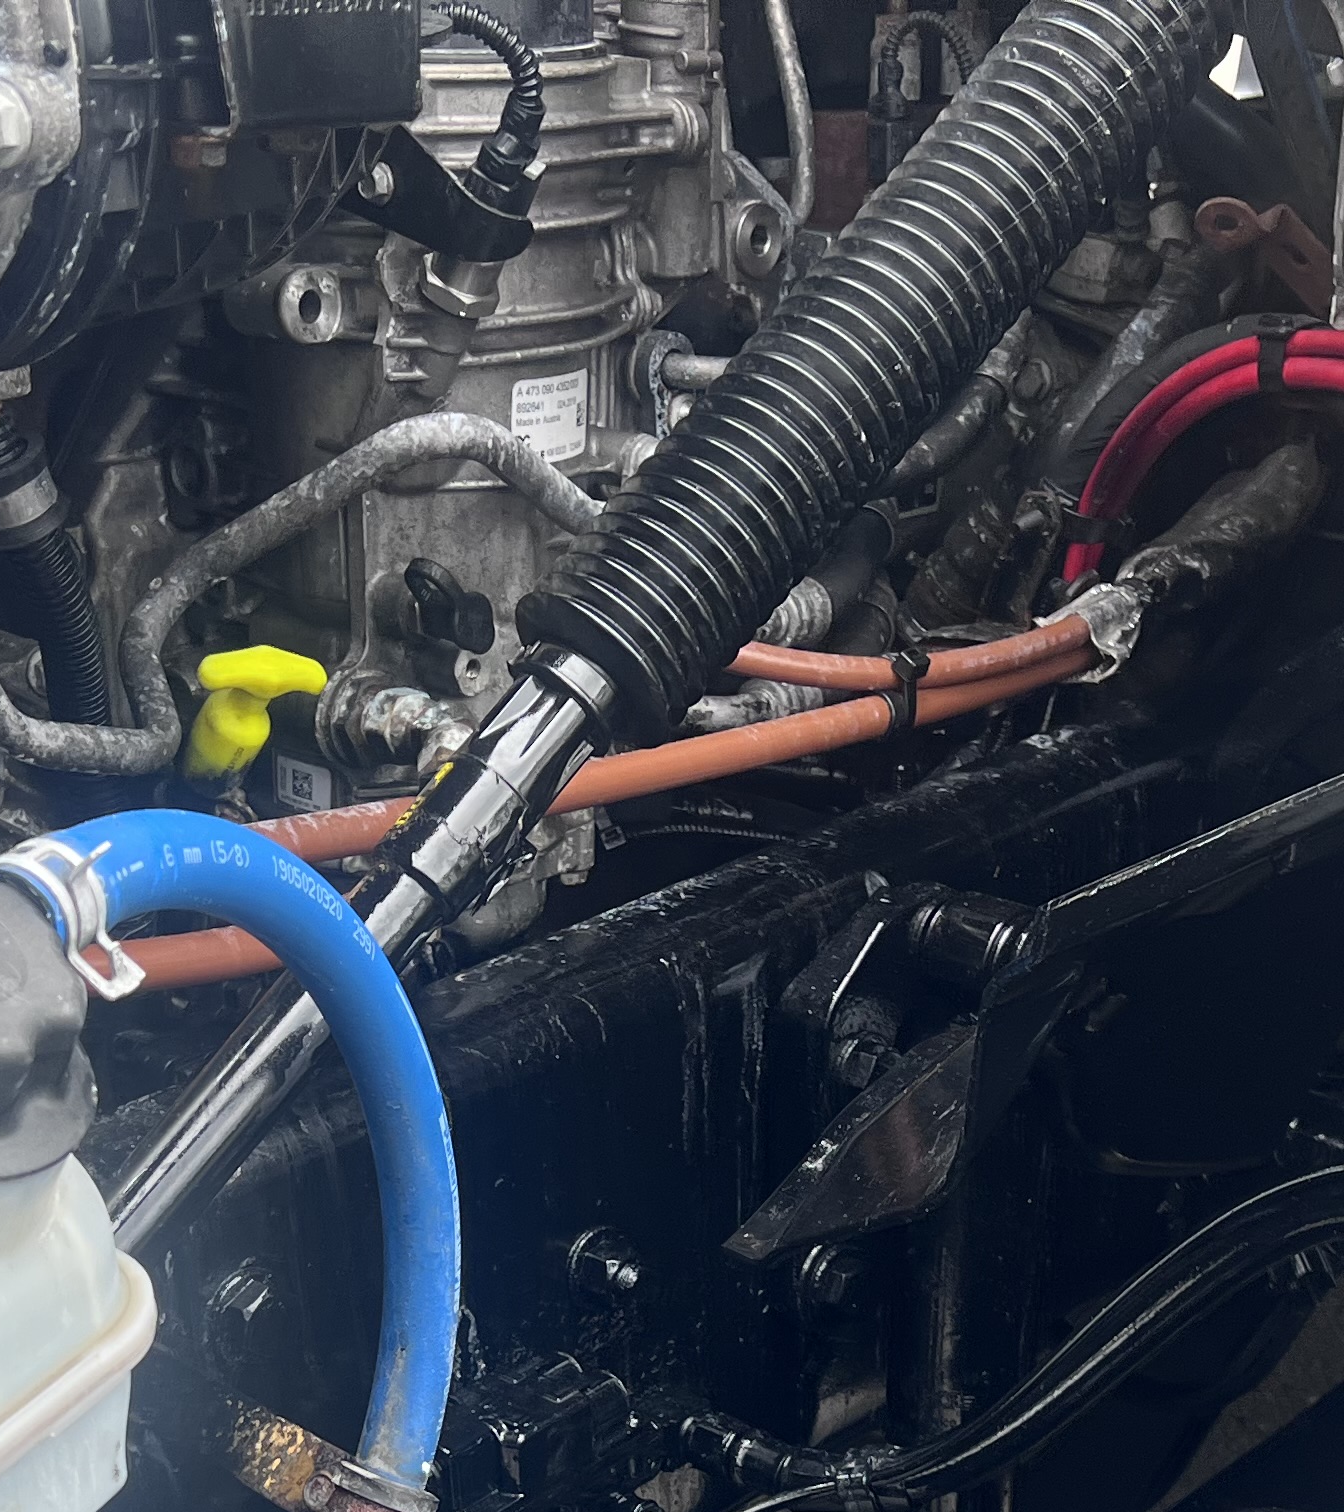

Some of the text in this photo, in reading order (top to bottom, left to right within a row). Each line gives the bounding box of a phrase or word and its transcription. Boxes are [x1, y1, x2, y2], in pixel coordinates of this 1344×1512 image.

[184, 847, 202, 865] mm
[210, 840, 250, 868] (5/8)
[272, 856, 343, 921] 1905020320
